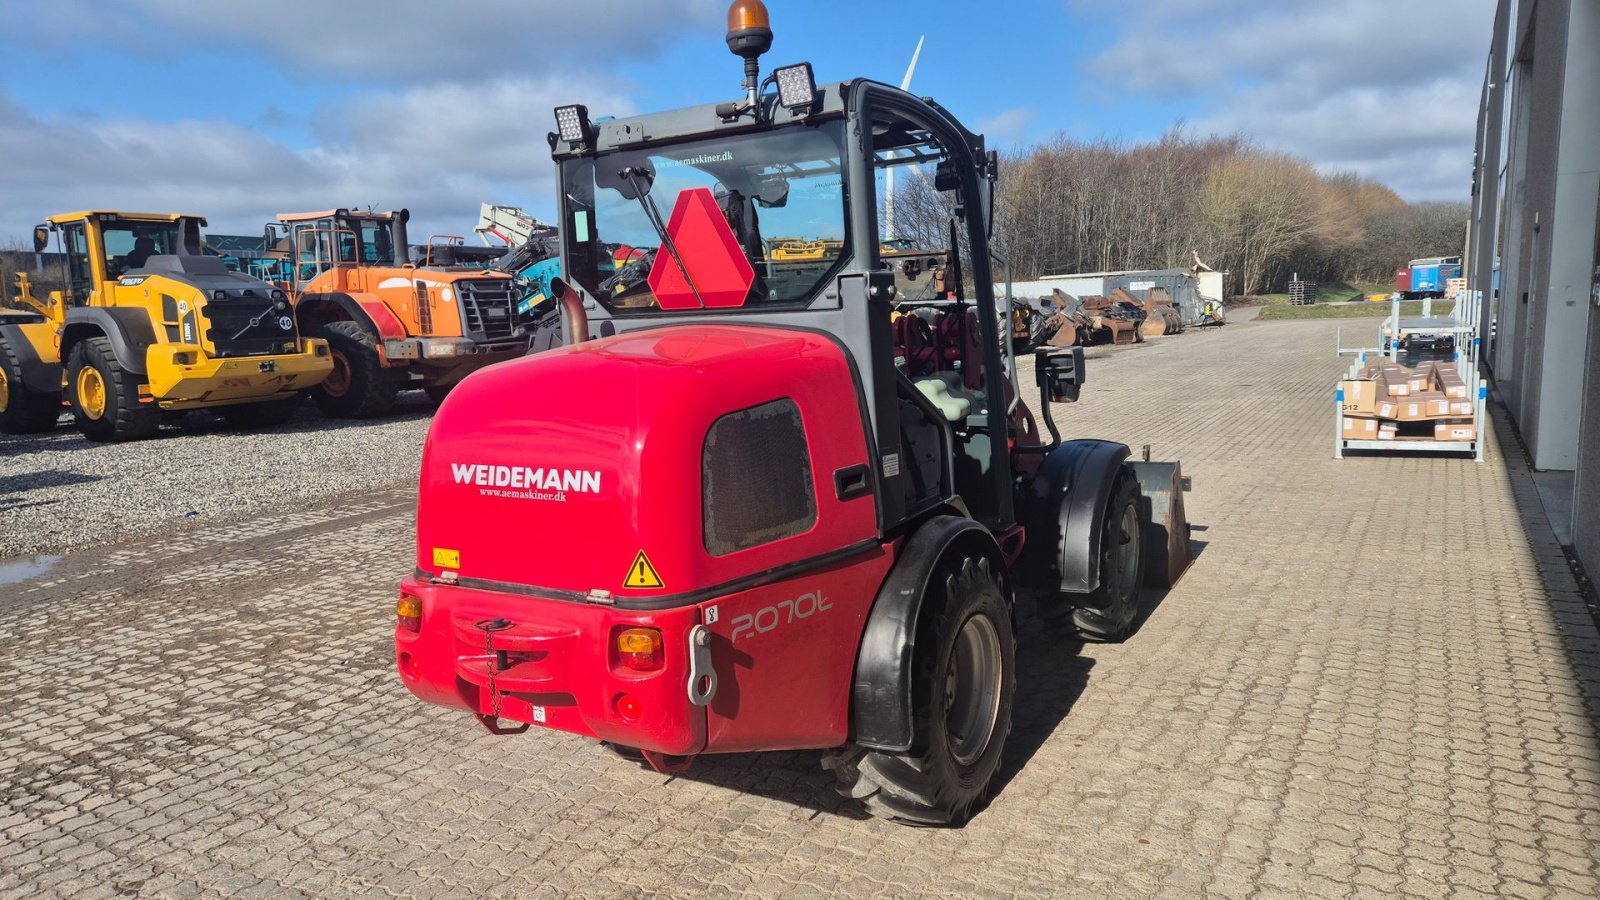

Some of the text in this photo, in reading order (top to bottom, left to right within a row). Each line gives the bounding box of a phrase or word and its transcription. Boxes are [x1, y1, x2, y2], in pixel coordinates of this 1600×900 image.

[280, 319, 292, 328] 40
[451, 463, 601, 494] WEIDEMANN
[479, 487, 567, 502] www.aemaskiner.dk
